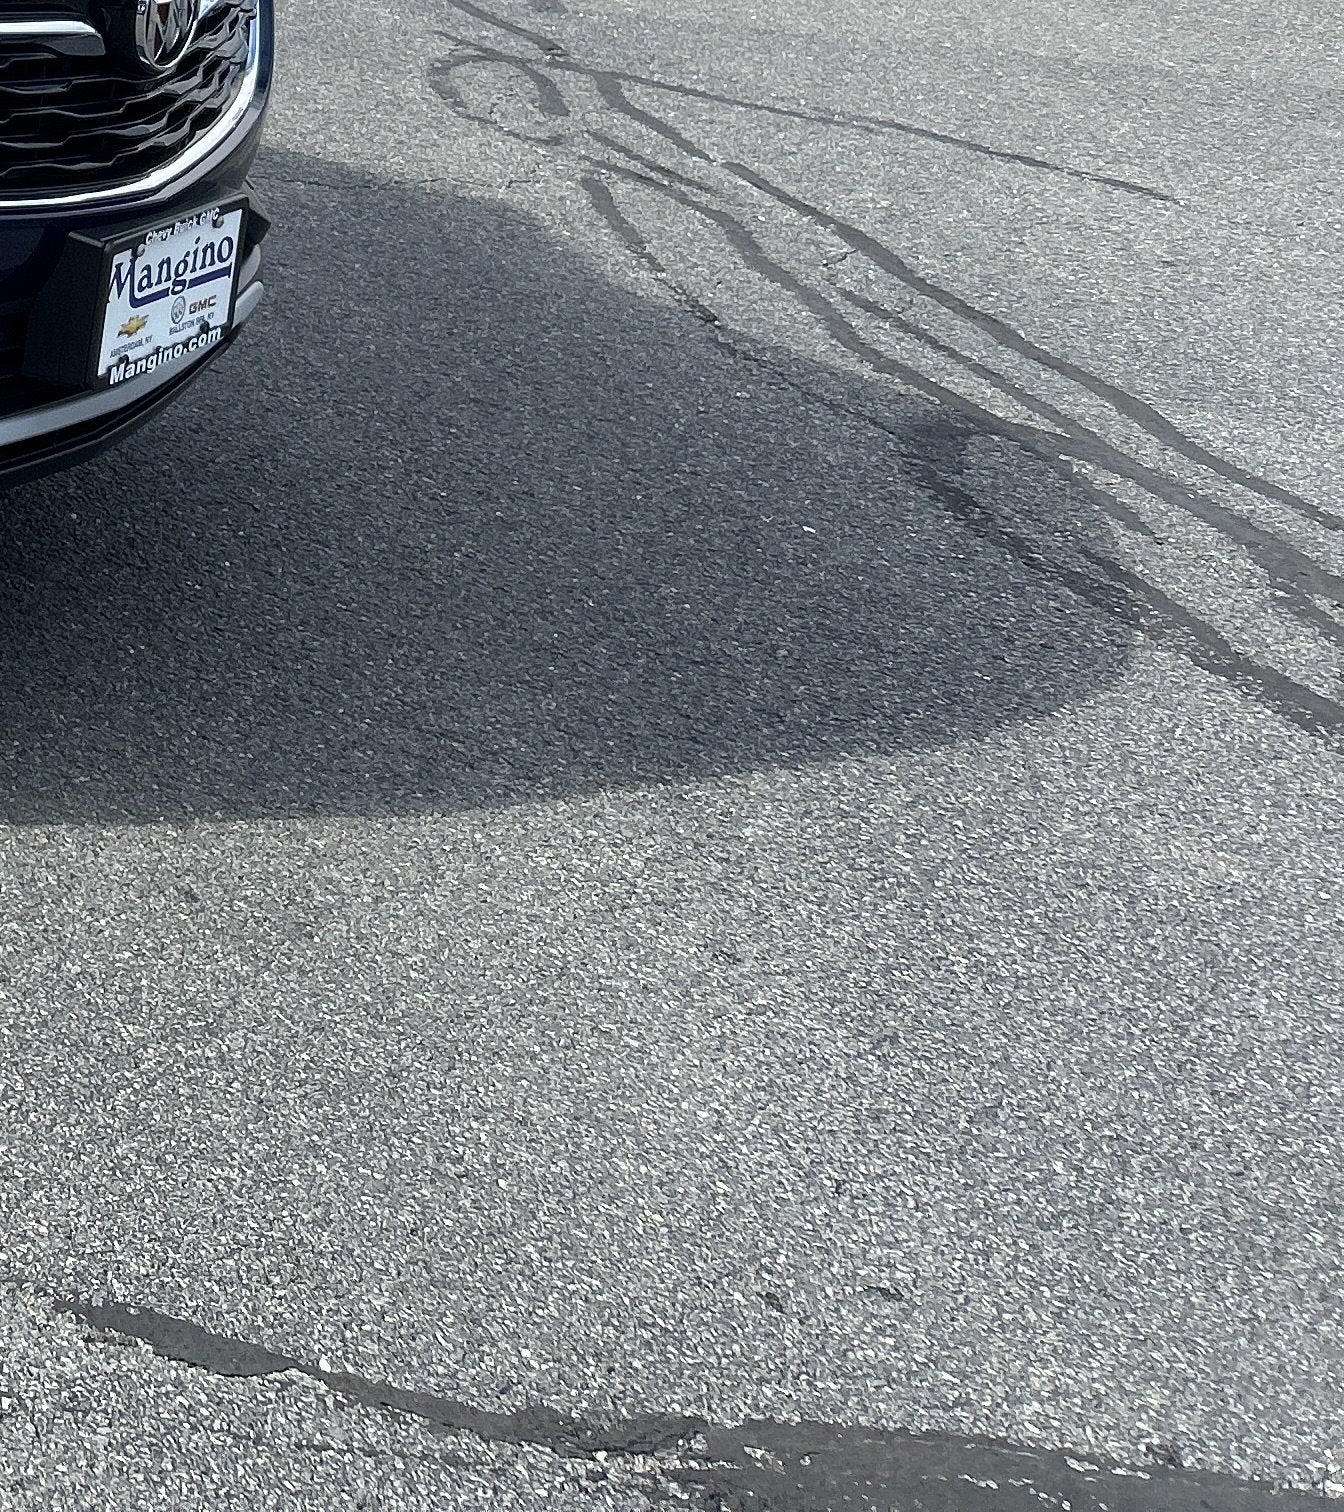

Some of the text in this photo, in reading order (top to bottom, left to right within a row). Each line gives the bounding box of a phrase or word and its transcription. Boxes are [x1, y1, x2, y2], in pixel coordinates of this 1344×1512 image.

[110, 236, 234, 306] Mangino
[189, 295, 217, 314] GMC
[110, 326, 221, 385] Mangino.com
